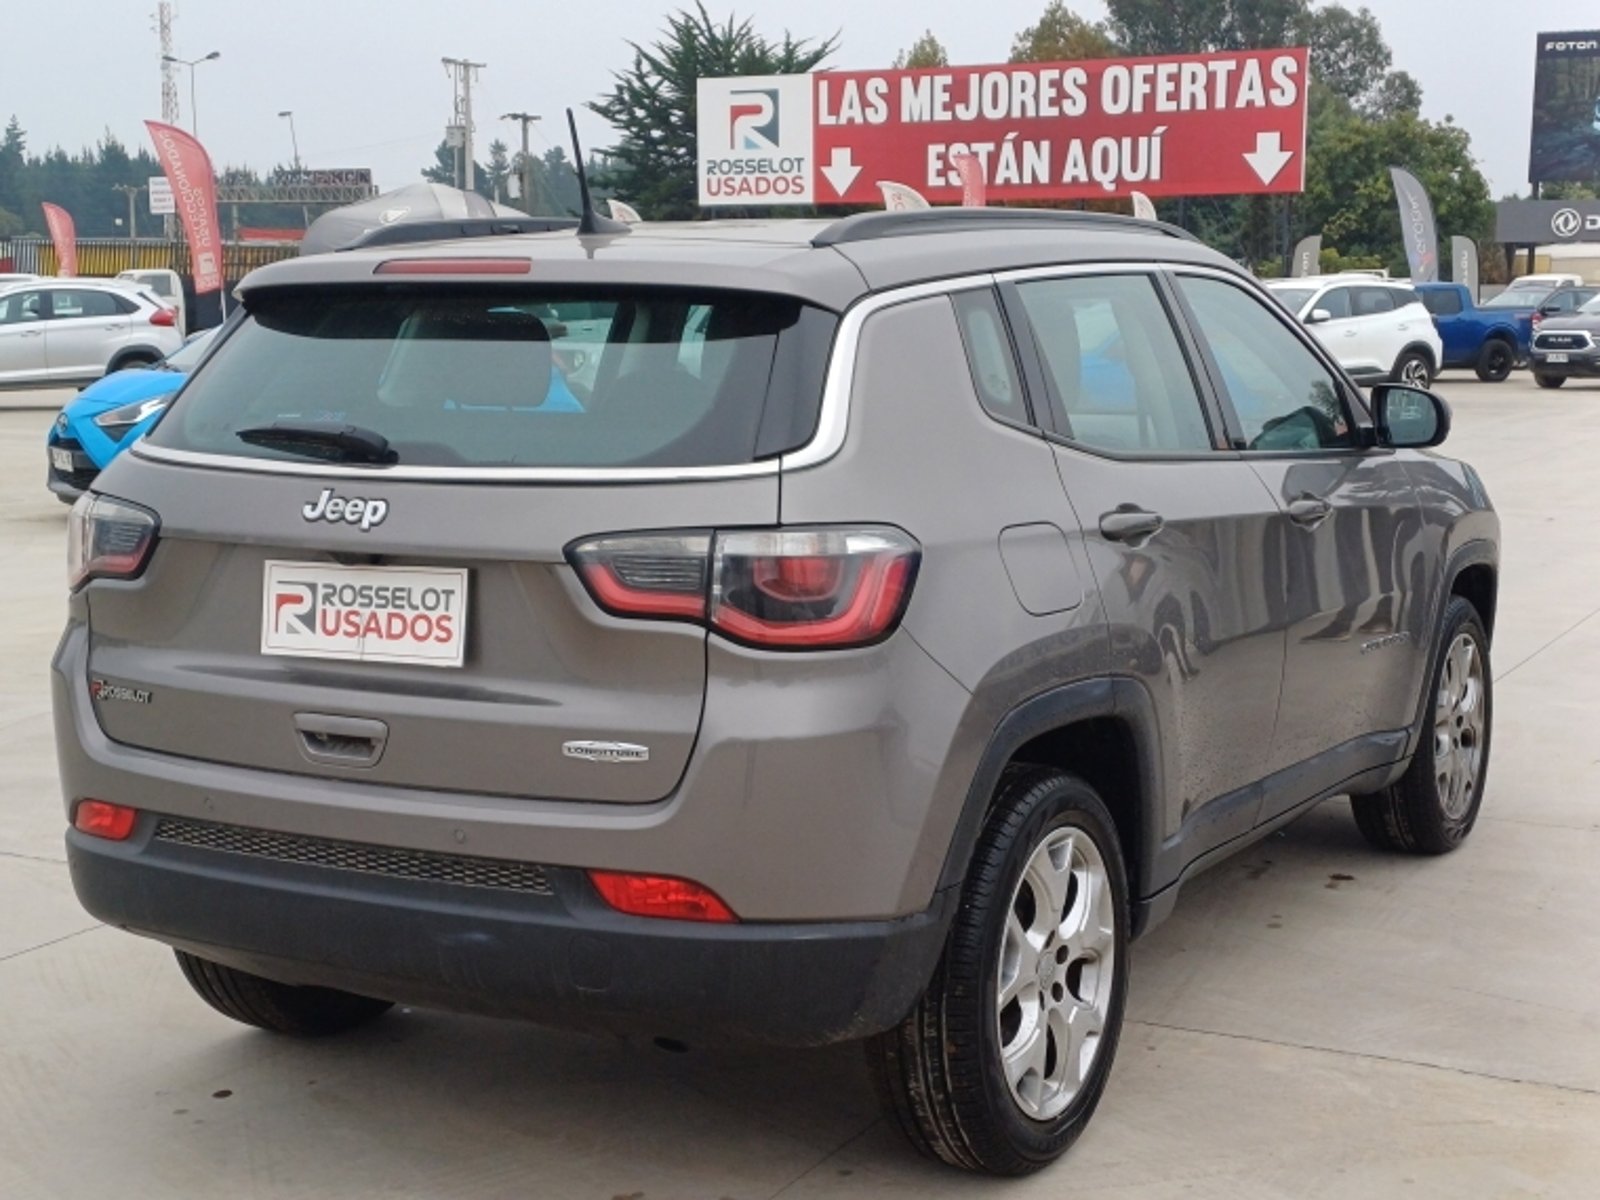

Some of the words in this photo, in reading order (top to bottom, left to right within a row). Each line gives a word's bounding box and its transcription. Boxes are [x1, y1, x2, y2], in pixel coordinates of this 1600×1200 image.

[1545, 40, 1597, 51] FOTON
[818, 77, 889, 125] LAS
[899, 67, 1088, 123] MEJORES
[1101, 56, 1298, 115] OFERTAS
[706, 157, 805, 175] ROSSELOT
[927, 131, 1051, 188] ESTÁN
[1062, 126, 1168, 192] AQUÍ
[706, 175, 805, 196] USADOS
[302, 488, 389, 531] Jeep
[321, 582, 456, 612] ROSSELOT
[320, 607, 454, 643] USADOS
